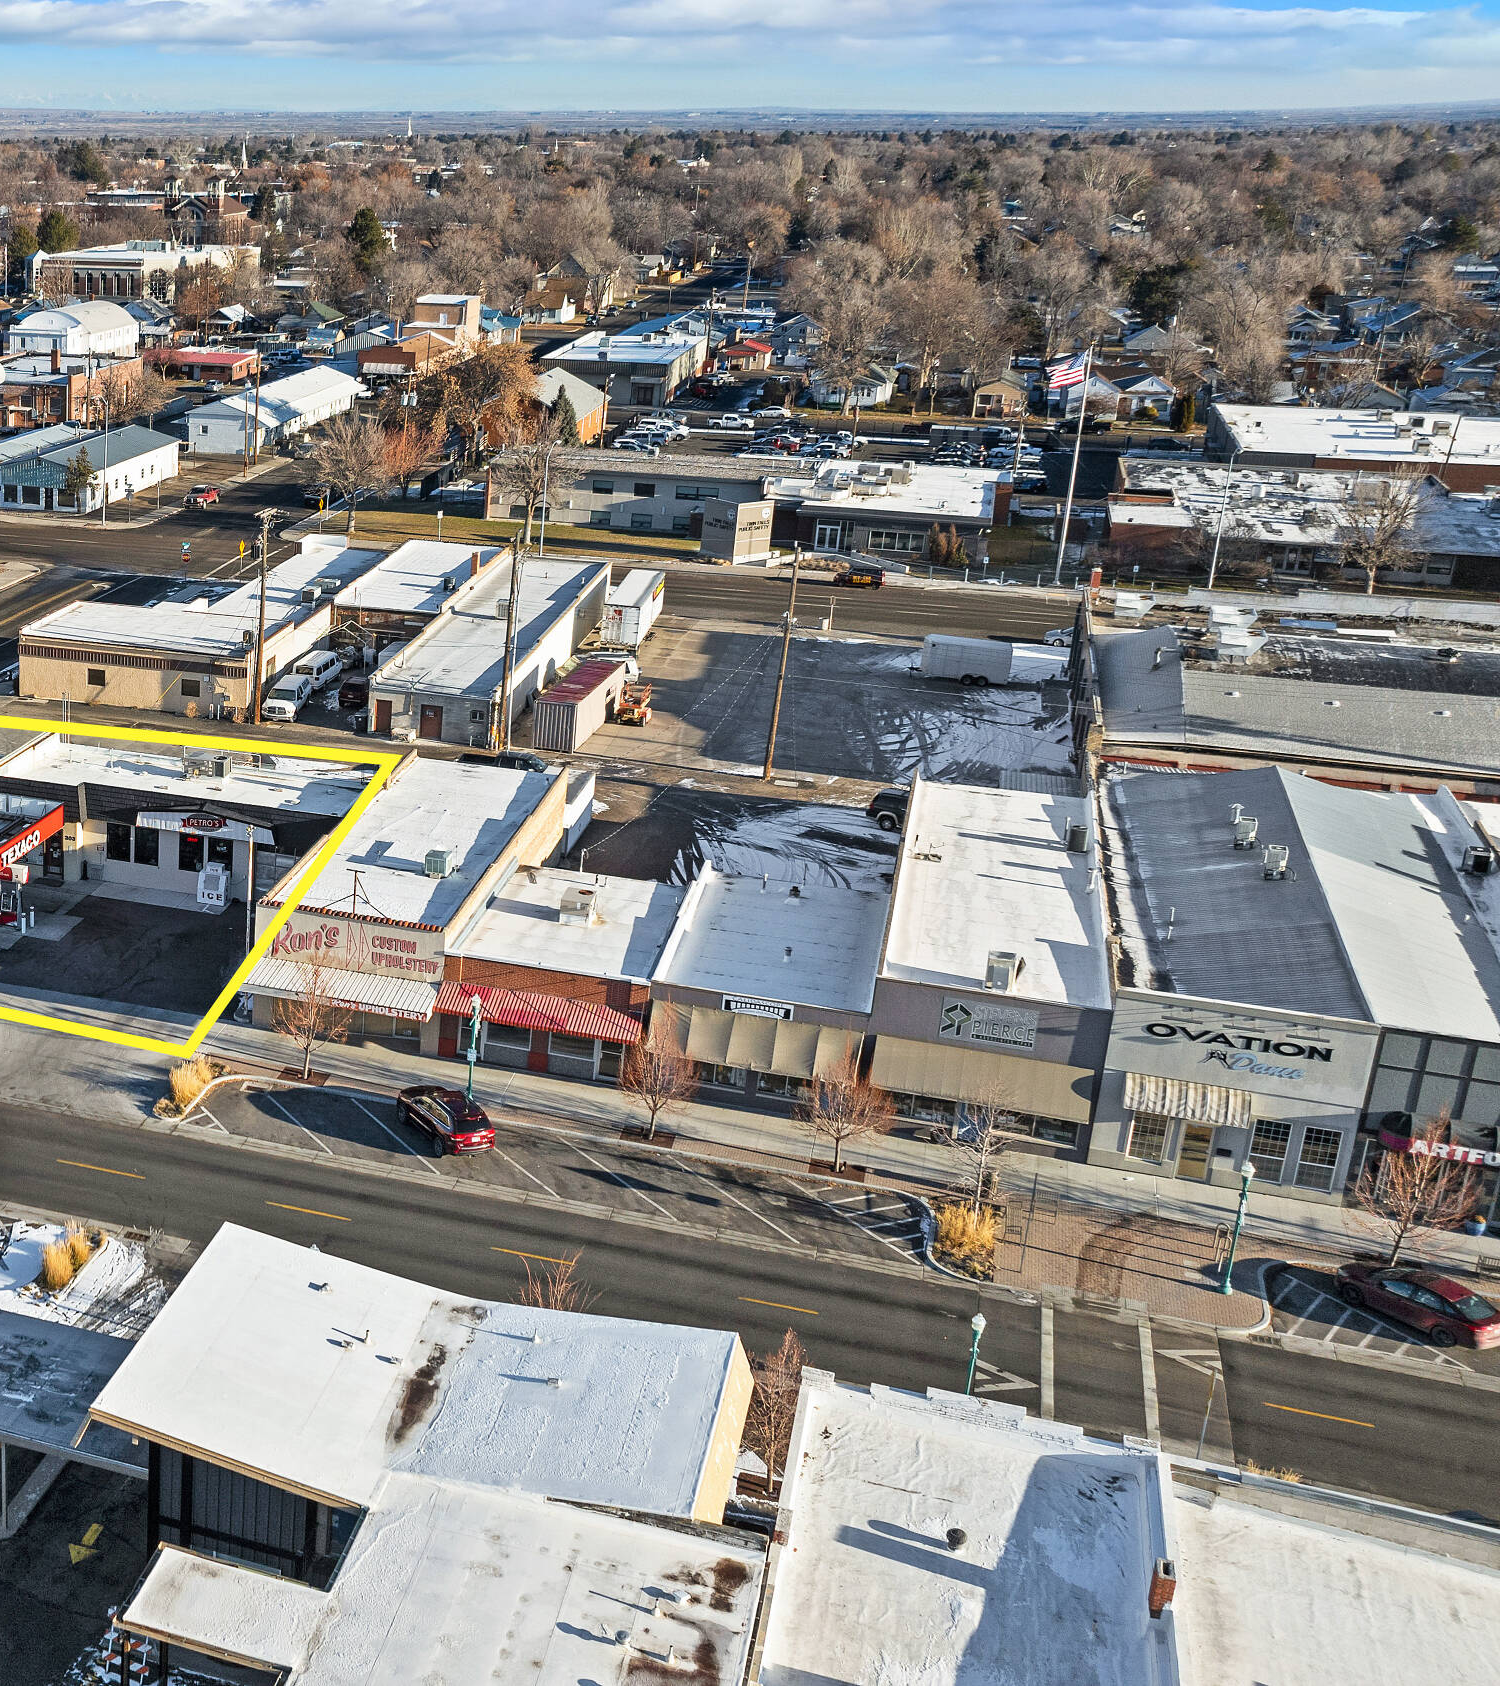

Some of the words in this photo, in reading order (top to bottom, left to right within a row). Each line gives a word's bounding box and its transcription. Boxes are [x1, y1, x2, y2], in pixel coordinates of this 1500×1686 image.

[188, 818, 220, 828] PETRO'S
[0, 829, 41, 867] TEXACO
[202, 891, 223, 902] ICE
[272, 920, 340, 957] Ron's
[371, 935, 417, 954] CUSTOM
[371, 951, 440, 975] UPHOLSTERY
[358, 1002, 425, 1021] UPHOLSTERY
[972, 1020, 1036, 1041] PIERCE
[1146, 1023, 1335, 1062] OVATION
[1230, 1053, 1306, 1079] Dance
